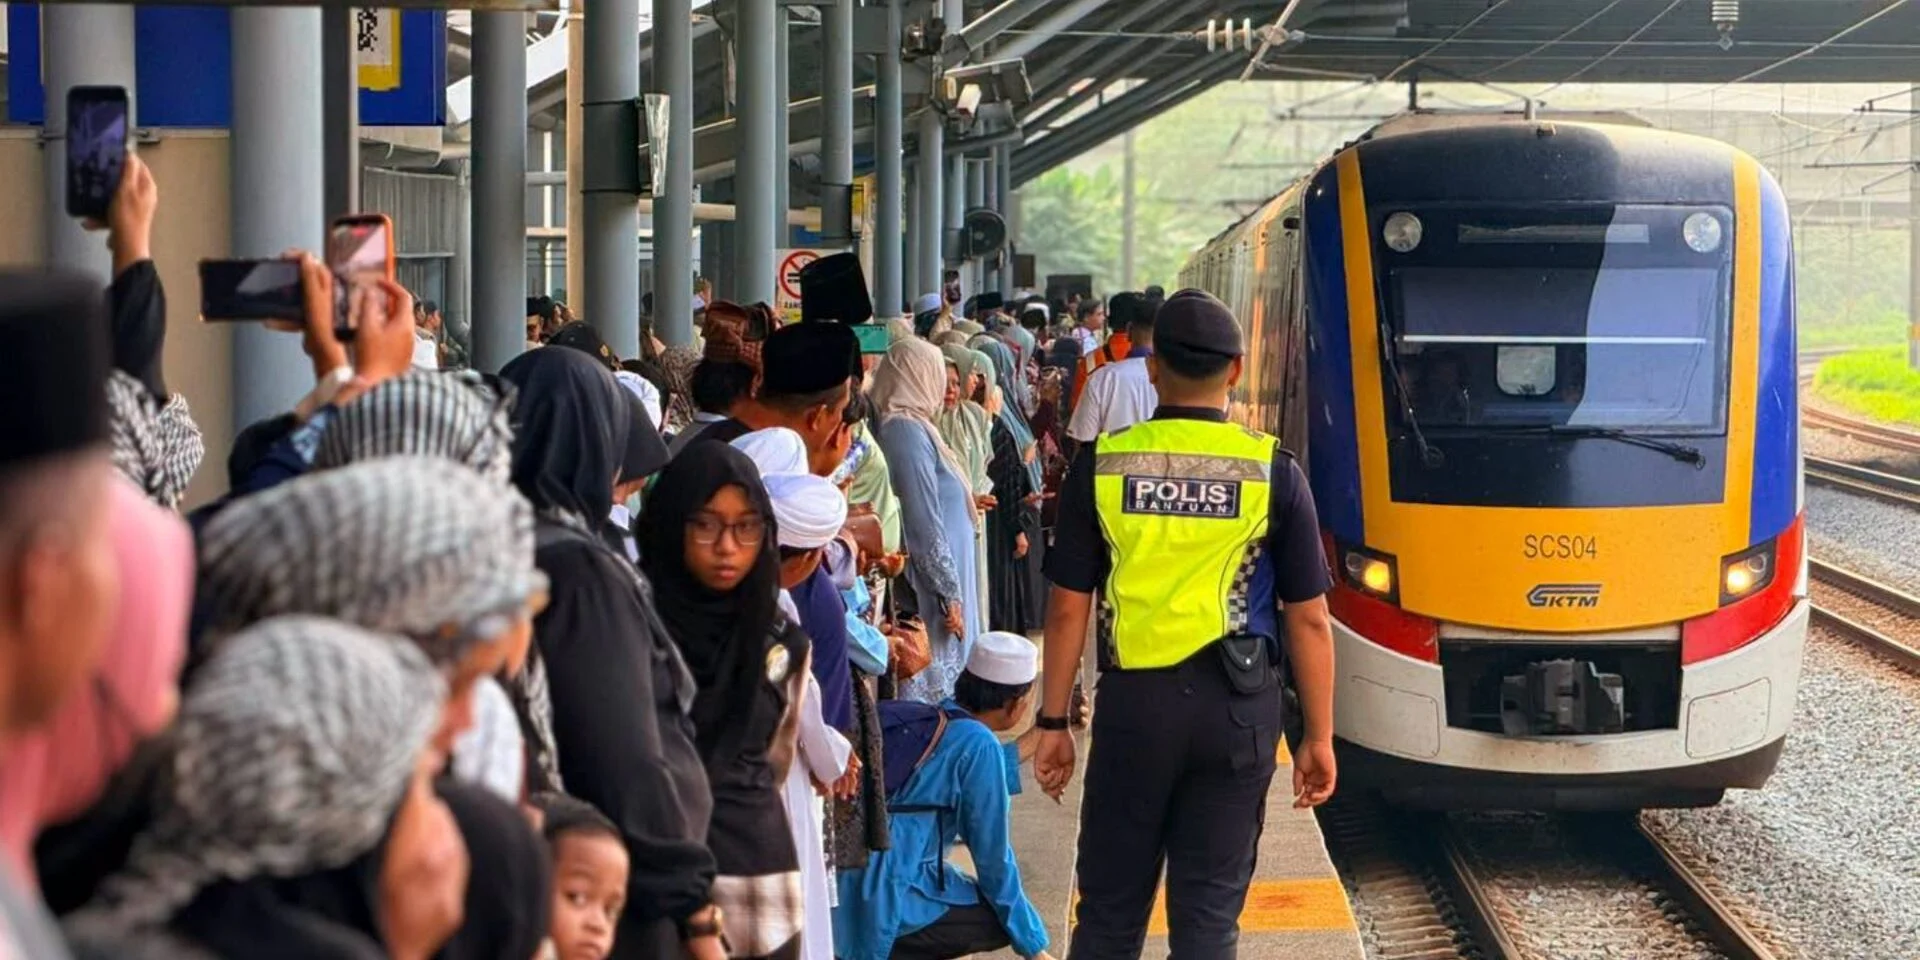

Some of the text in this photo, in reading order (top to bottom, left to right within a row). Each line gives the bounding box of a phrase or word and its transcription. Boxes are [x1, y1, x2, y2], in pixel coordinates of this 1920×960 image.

[1135, 480, 1229, 505] POLIS
[1135, 500, 1228, 514] BANTUAN
[1523, 533, 1598, 560] SCS04
